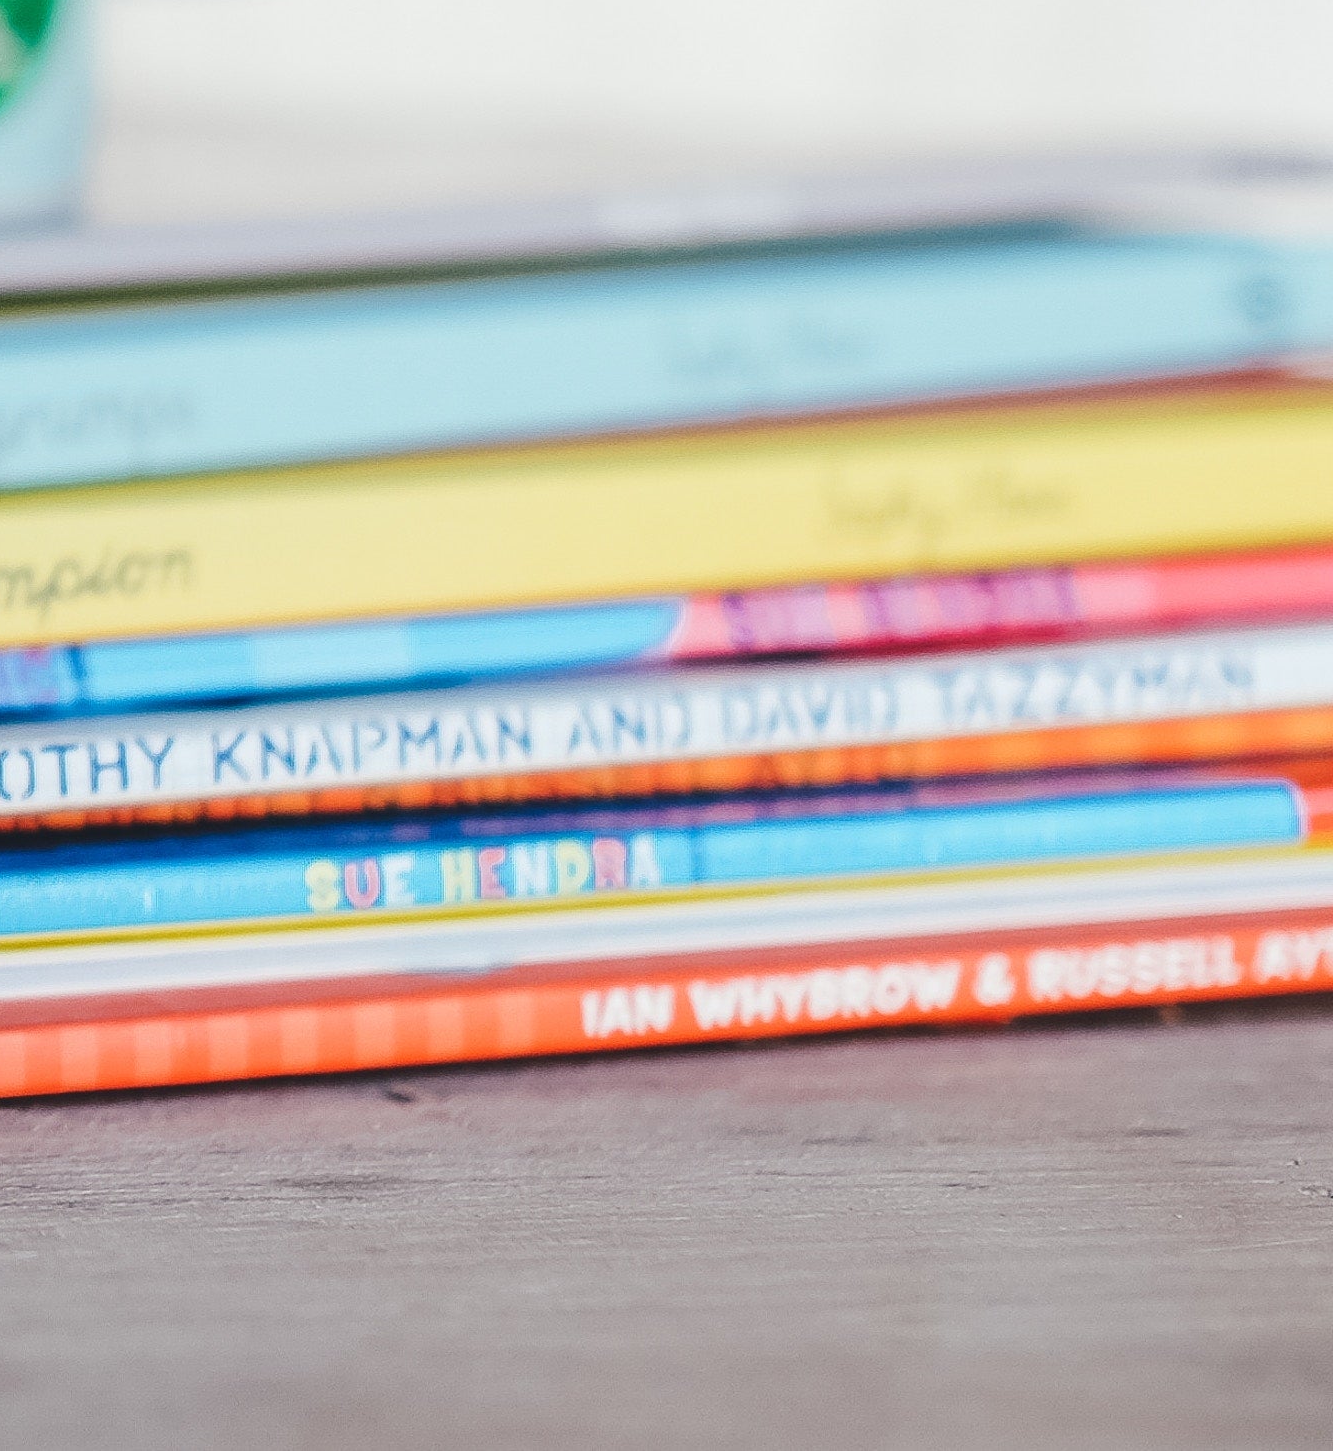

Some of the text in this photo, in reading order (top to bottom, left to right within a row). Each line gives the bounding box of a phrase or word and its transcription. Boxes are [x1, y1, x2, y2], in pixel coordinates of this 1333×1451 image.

[214, 708, 530, 781] KNAPMAN
[570, 696, 688, 753] AND
[724, 677, 895, 744] DAVID
[306, 857, 415, 911] SUE
[441, 836, 658, 896] HENDRA
[582, 987, 671, 1037] IAN
[690, 961, 960, 1030] WHYBROW
[976, 954, 1014, 1006] &
[1027, 937, 1239, 1000] RUSSELL
